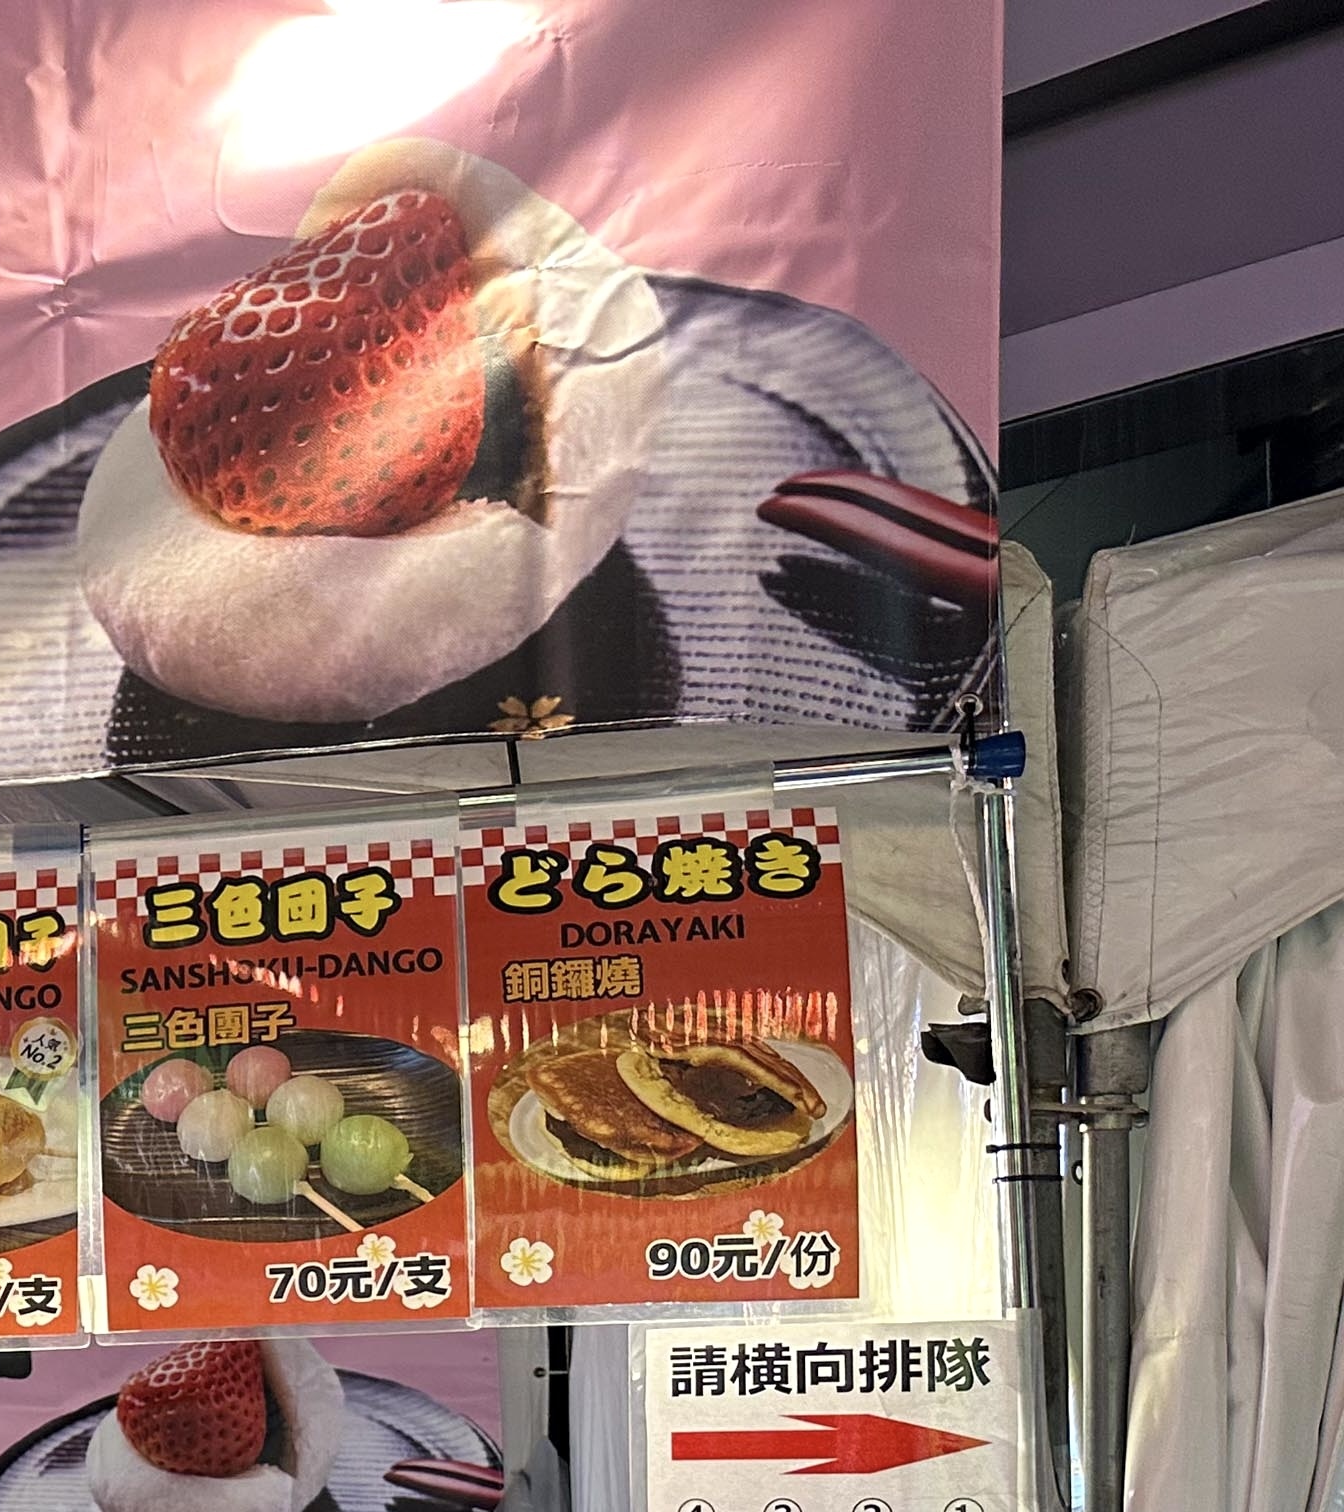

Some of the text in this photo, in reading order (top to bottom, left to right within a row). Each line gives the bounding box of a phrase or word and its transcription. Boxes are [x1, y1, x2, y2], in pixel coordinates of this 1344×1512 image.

[490, 834, 820, 912] どら焼き
[147, 868, 402, 948] 三色団子
[559, 914, 746, 949] DORAYAKI
[120, 946, 443, 995] SANSHOKU-DANGO
[504, 955, 642, 1001] 銅鑼燒
[121, 1002, 294, 1052] 三色團子
[20, 1044, 63, 1070] No.2
[265, 1253, 451, 1303] 70元/支
[647, 1232, 839, 1284] 90元/份
